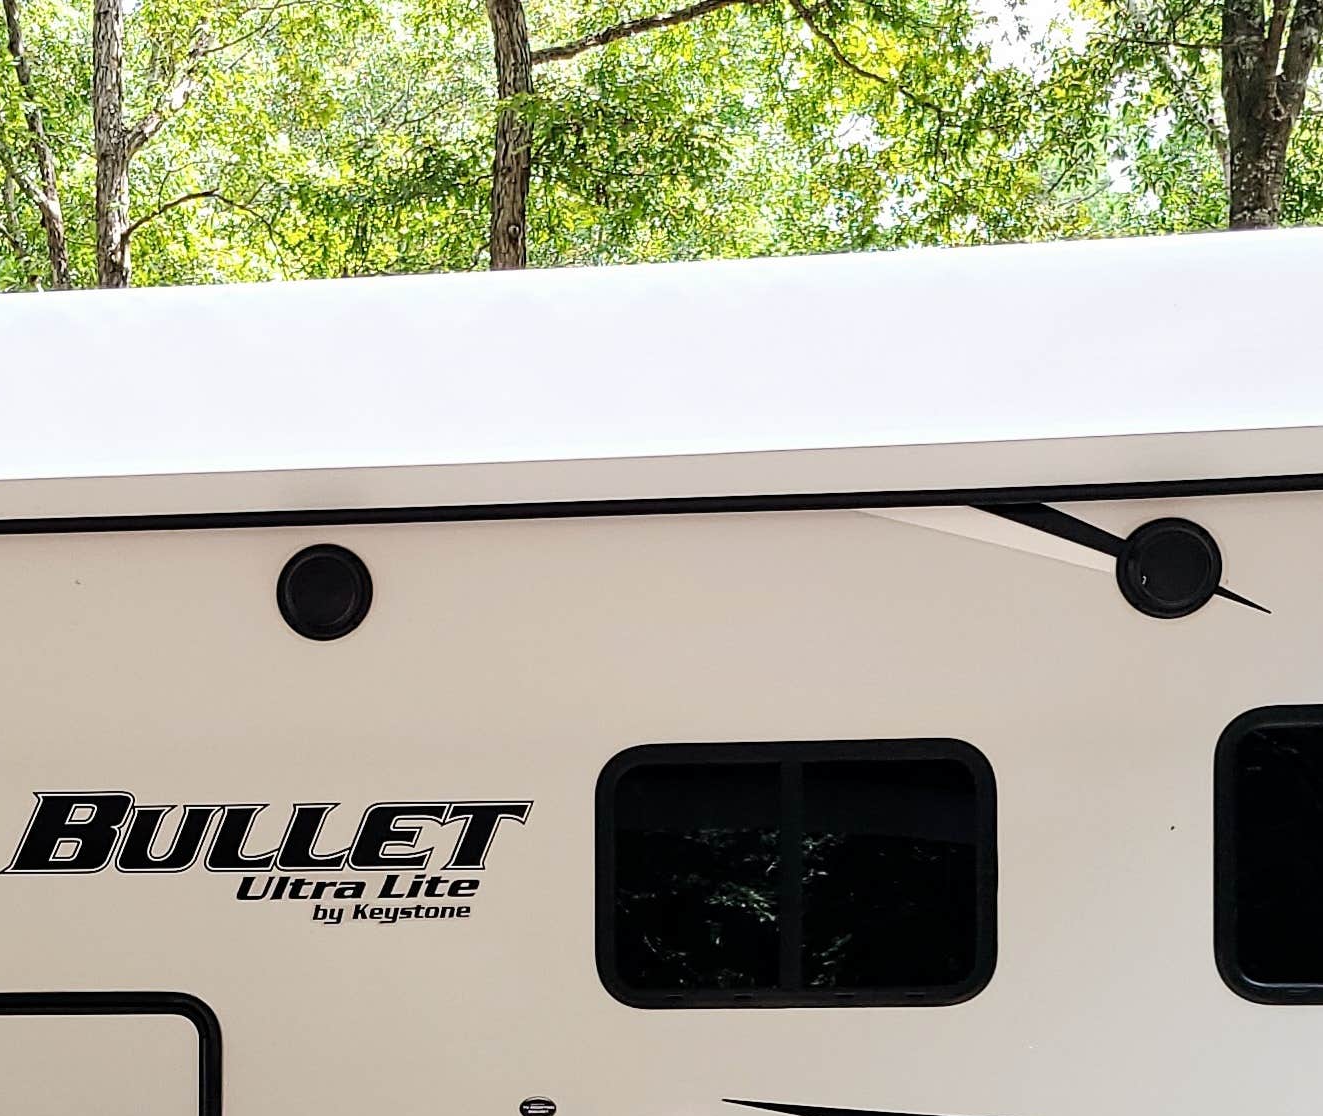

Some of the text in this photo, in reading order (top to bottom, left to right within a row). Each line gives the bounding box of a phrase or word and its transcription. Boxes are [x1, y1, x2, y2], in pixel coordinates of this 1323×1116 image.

[235, 874, 480, 901] Ultra Lite
[312, 902, 471, 924] by Keystone
